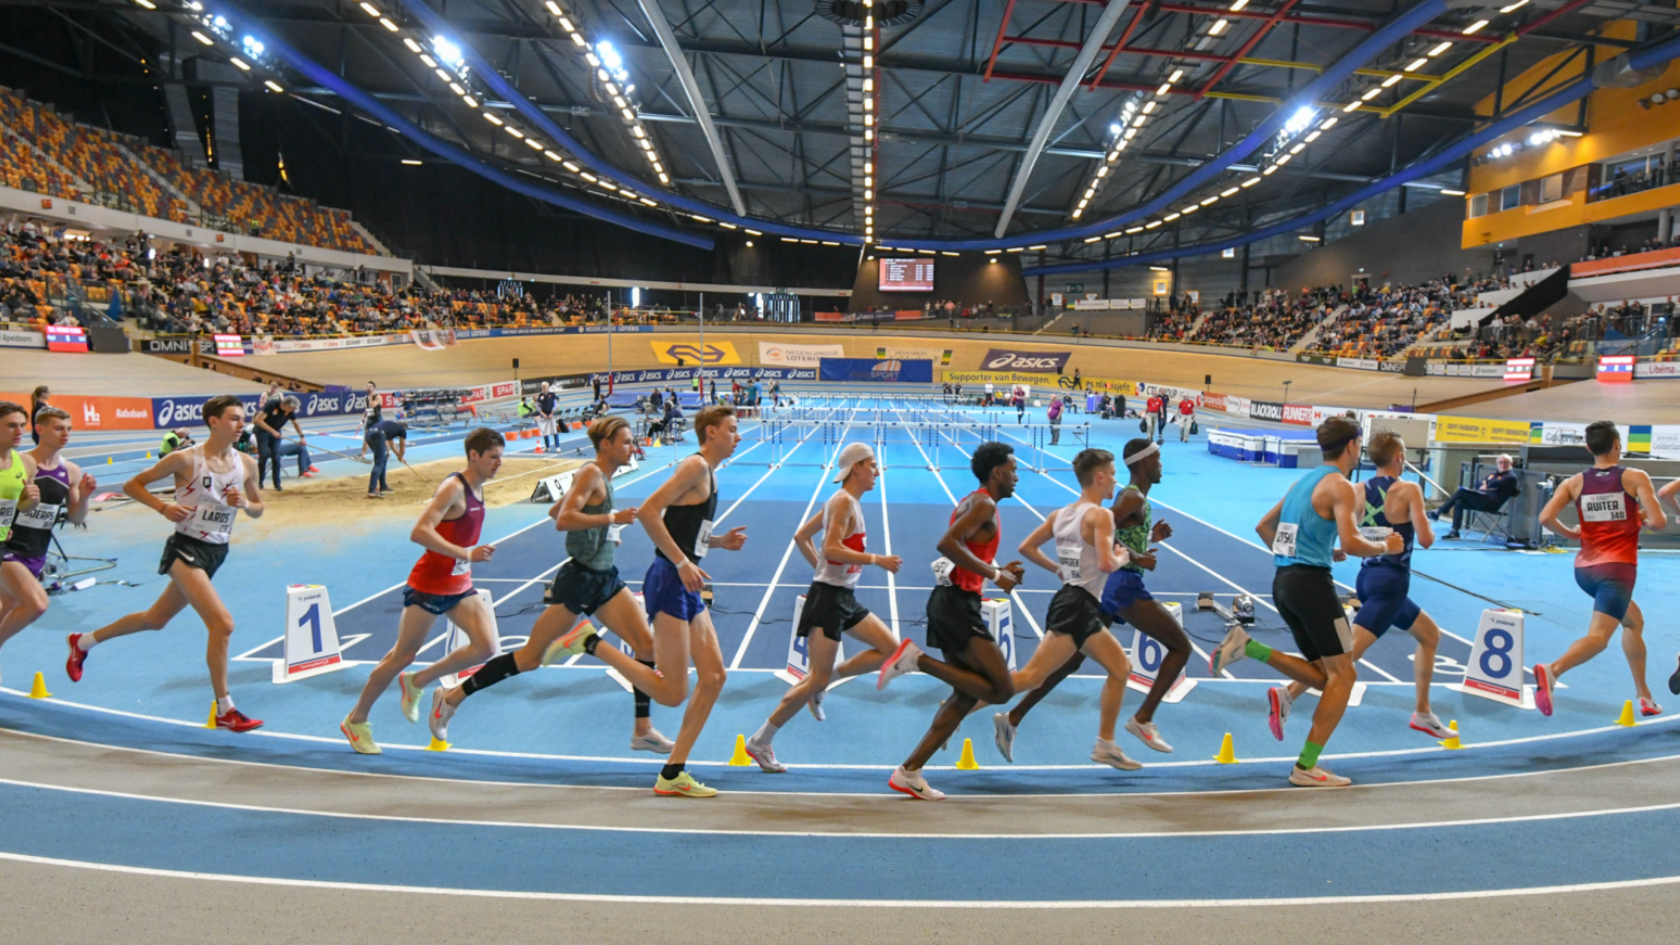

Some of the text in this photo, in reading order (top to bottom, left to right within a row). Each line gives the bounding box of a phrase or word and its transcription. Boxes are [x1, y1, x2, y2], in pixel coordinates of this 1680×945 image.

[1011, 356, 1059, 368] asics
[949, 373, 1051, 385] Supporter van Bewegen.
[317, 398, 339, 412] asics
[1250, 403, 1282, 420] BLACKROLL
[115, 408, 148, 419] Rabobank
[1586, 500, 1619, 511] RUITER
[1610, 511, 1625, 520] 340
[298, 602, 323, 654] 1
[1138, 631, 1162, 673] 6
[1479, 627, 1515, 679] 8
